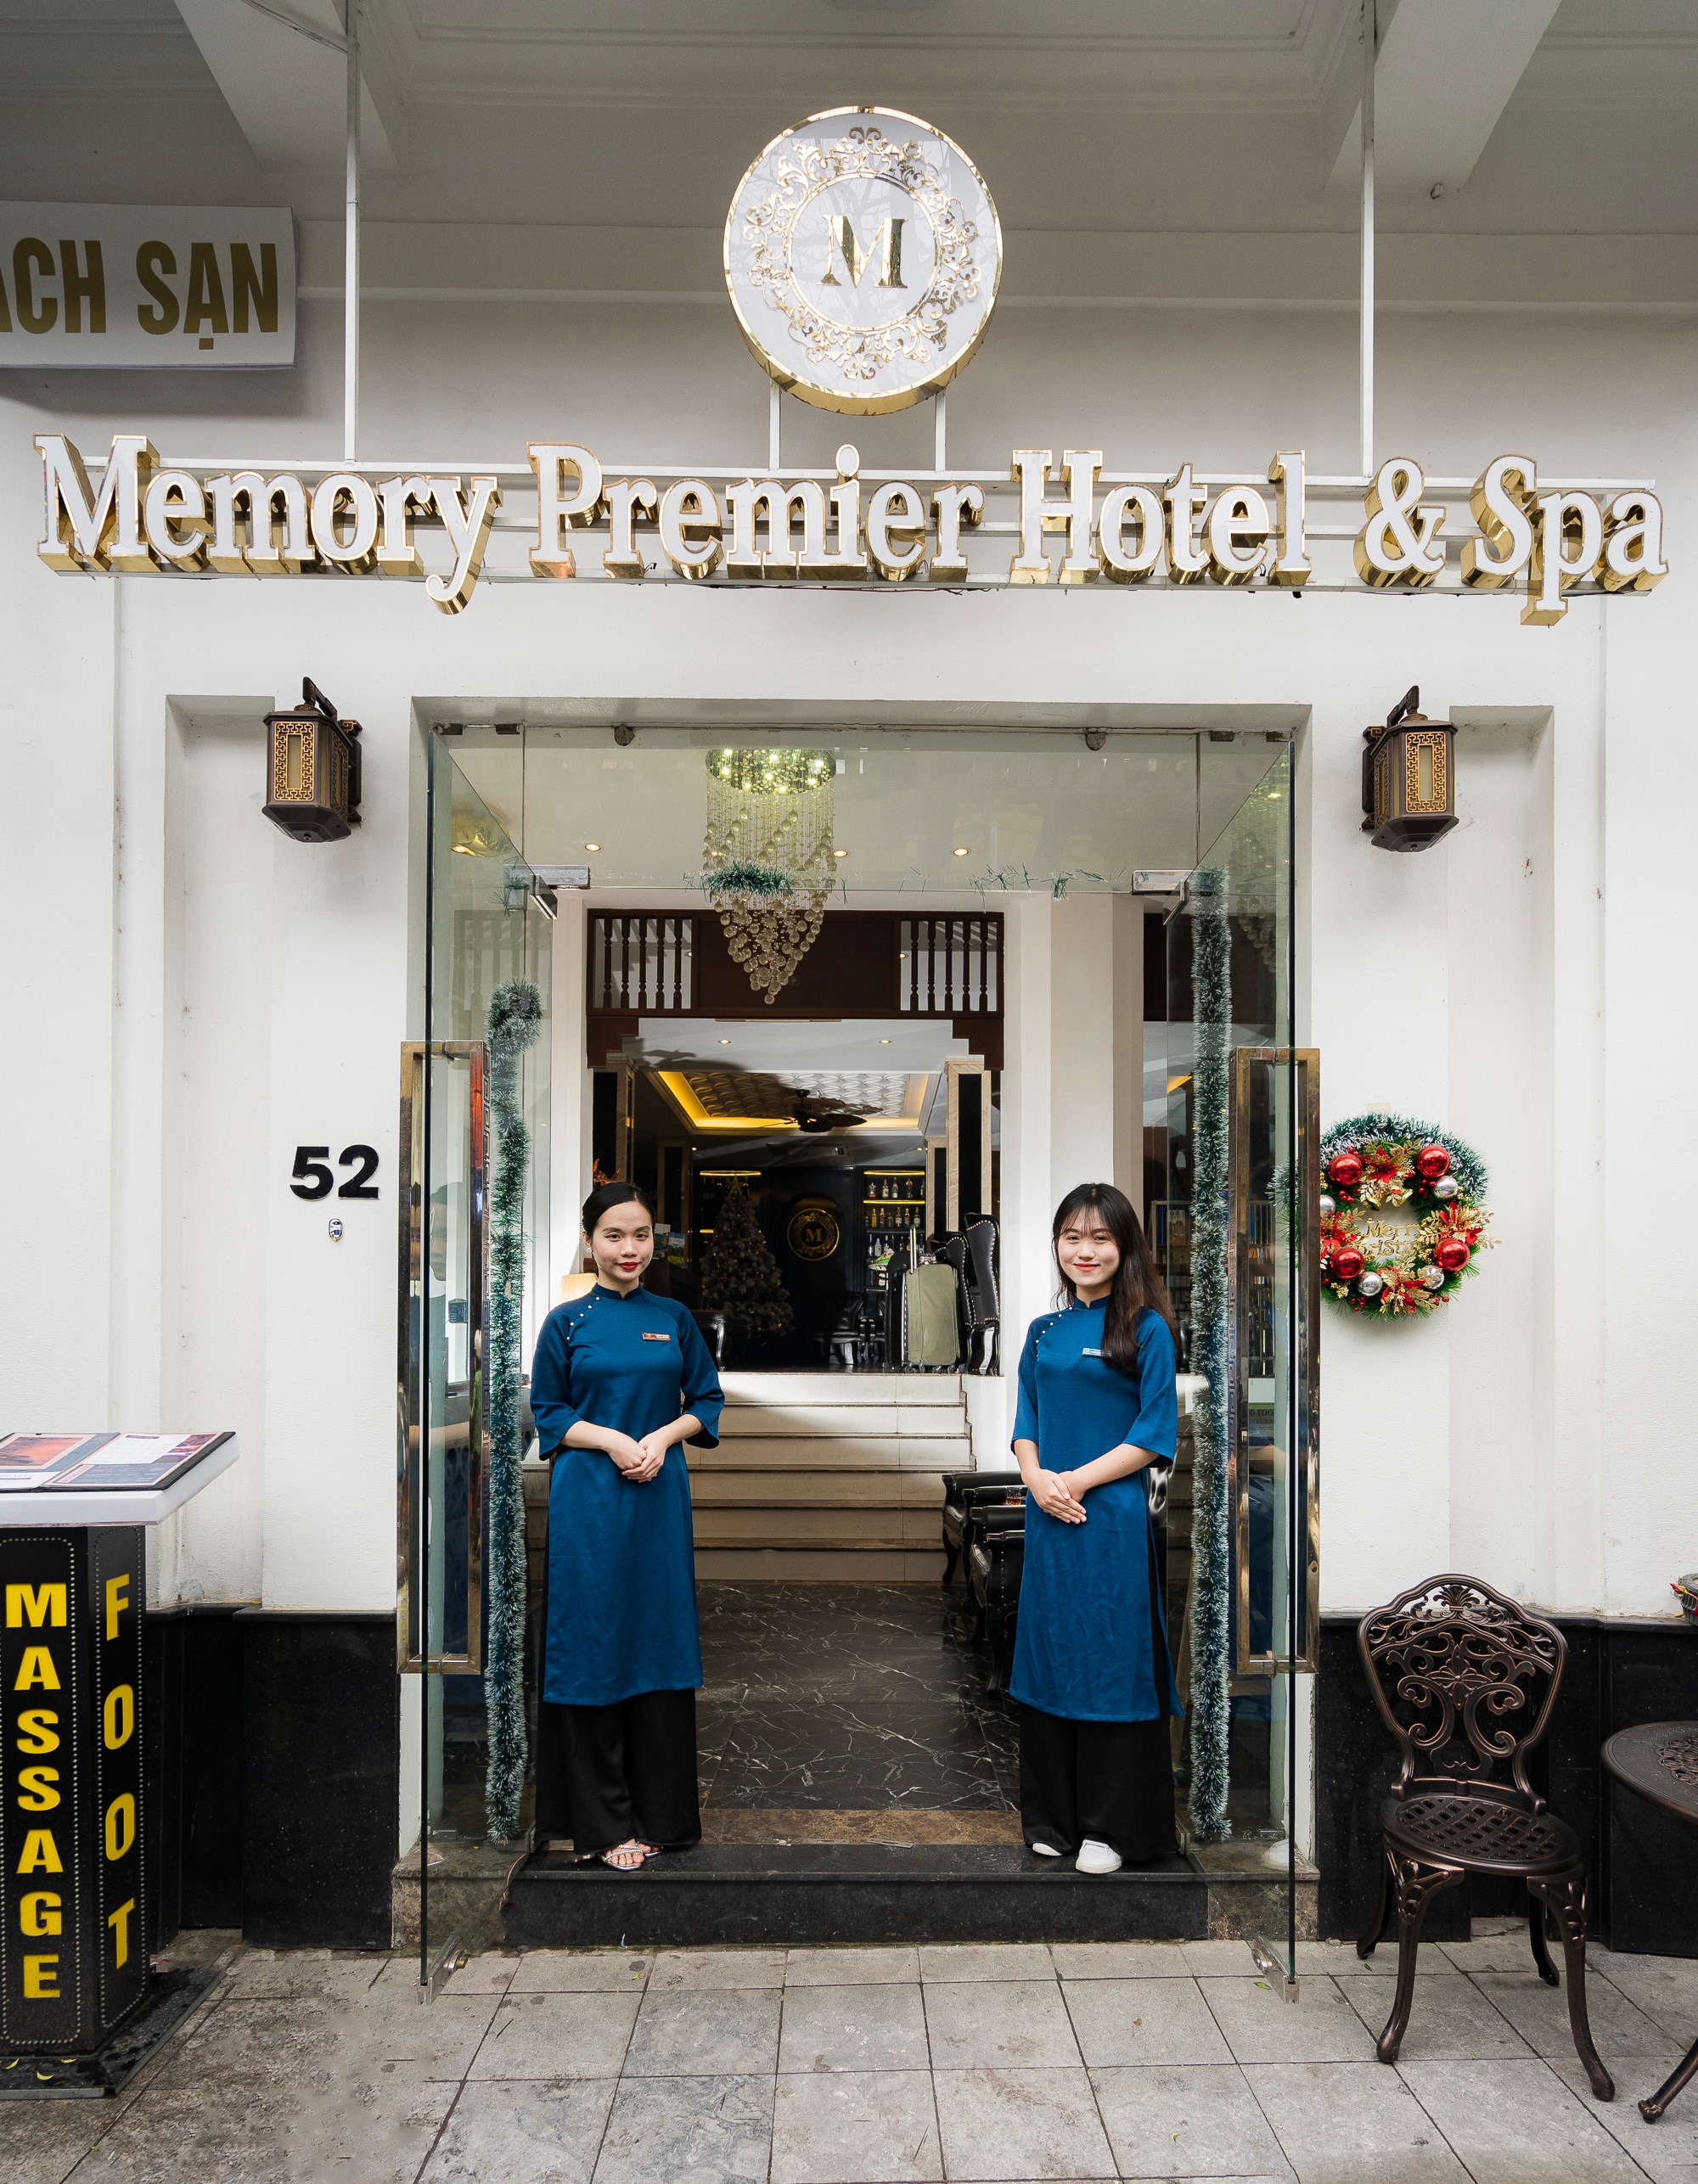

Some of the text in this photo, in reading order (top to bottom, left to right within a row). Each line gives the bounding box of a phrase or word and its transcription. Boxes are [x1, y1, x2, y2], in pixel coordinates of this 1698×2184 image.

[0, 237, 278, 350] CH SẠN
[816, 214, 908, 289] M
[33, 433, 1670, 625] Memory Premier Hotel & Spa
[290, 1144, 380, 1201] 52
[805, 1228, 823, 1243] M
[5, 1583, 68, 1999] MASSAGE
[104, 1573, 136, 1970] FOOT
